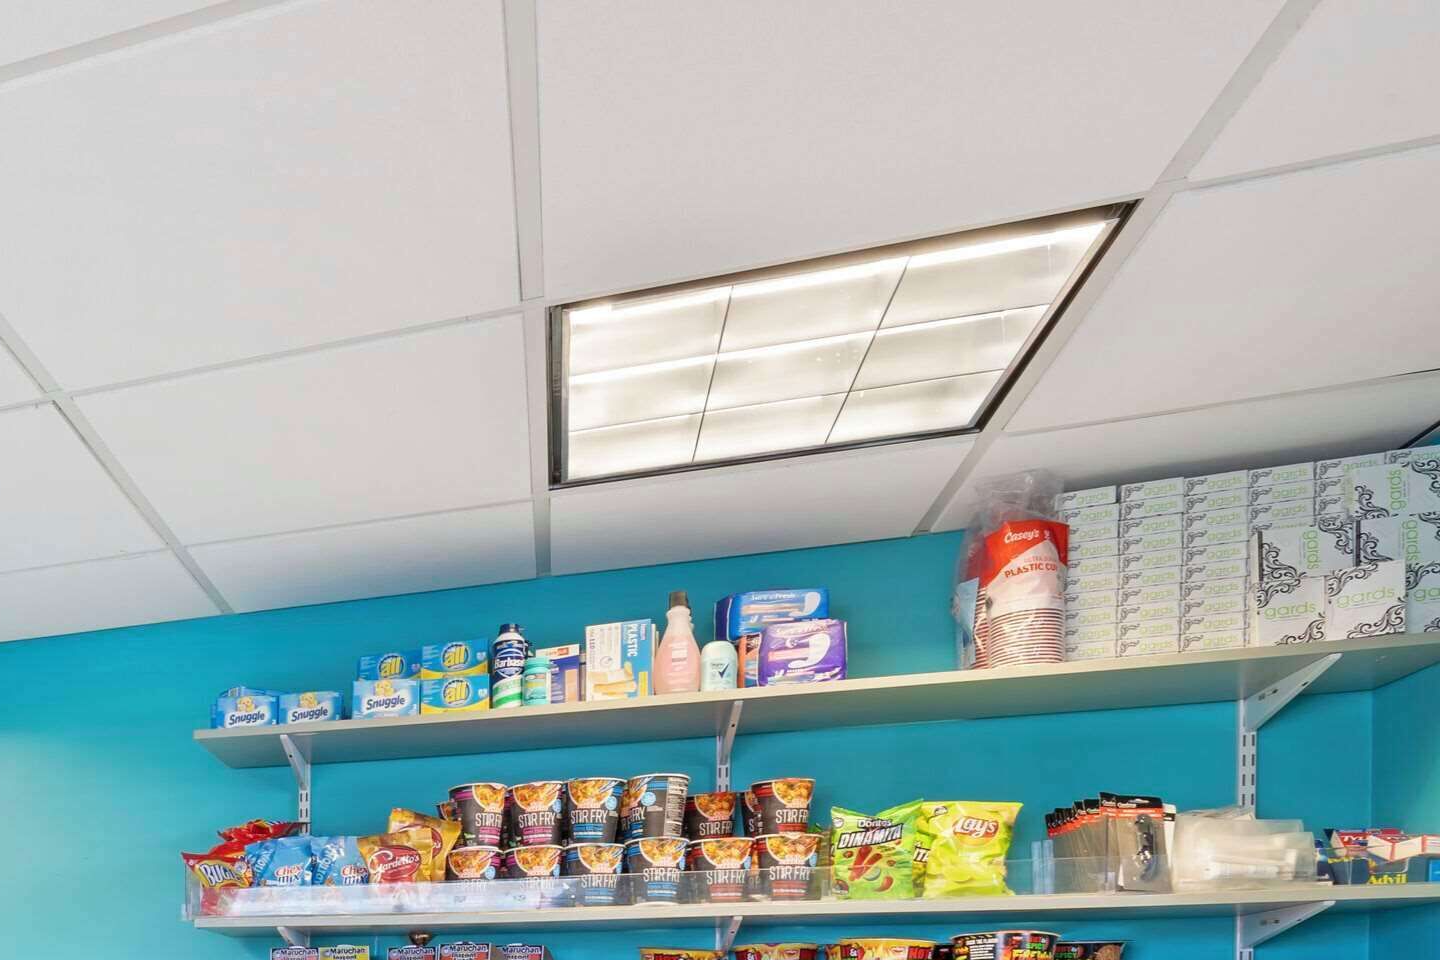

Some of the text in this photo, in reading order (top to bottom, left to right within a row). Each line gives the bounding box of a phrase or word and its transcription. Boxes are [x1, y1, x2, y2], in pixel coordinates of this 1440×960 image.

[1004, 528, 1039, 543] Casey's
[1303, 529, 1319, 570] gards
[1004, 562, 1044, 578] PLASTIC
[1335, 586, 1396, 608] gards
[1264, 602, 1317, 619] gards
[443, 645, 467, 669] all
[380, 656, 402, 676] all
[444, 679, 467, 702] all
[366, 695, 406, 711] Snuggle
[228, 710, 266, 726] Snuggle
[291, 706, 329, 722] Snuggle
[518, 812, 556, 829] STIR FRY
[570, 809, 609, 825] STIR FRY
[954, 817, 998, 838] Lay's
[274, 864, 302, 878] Chex
